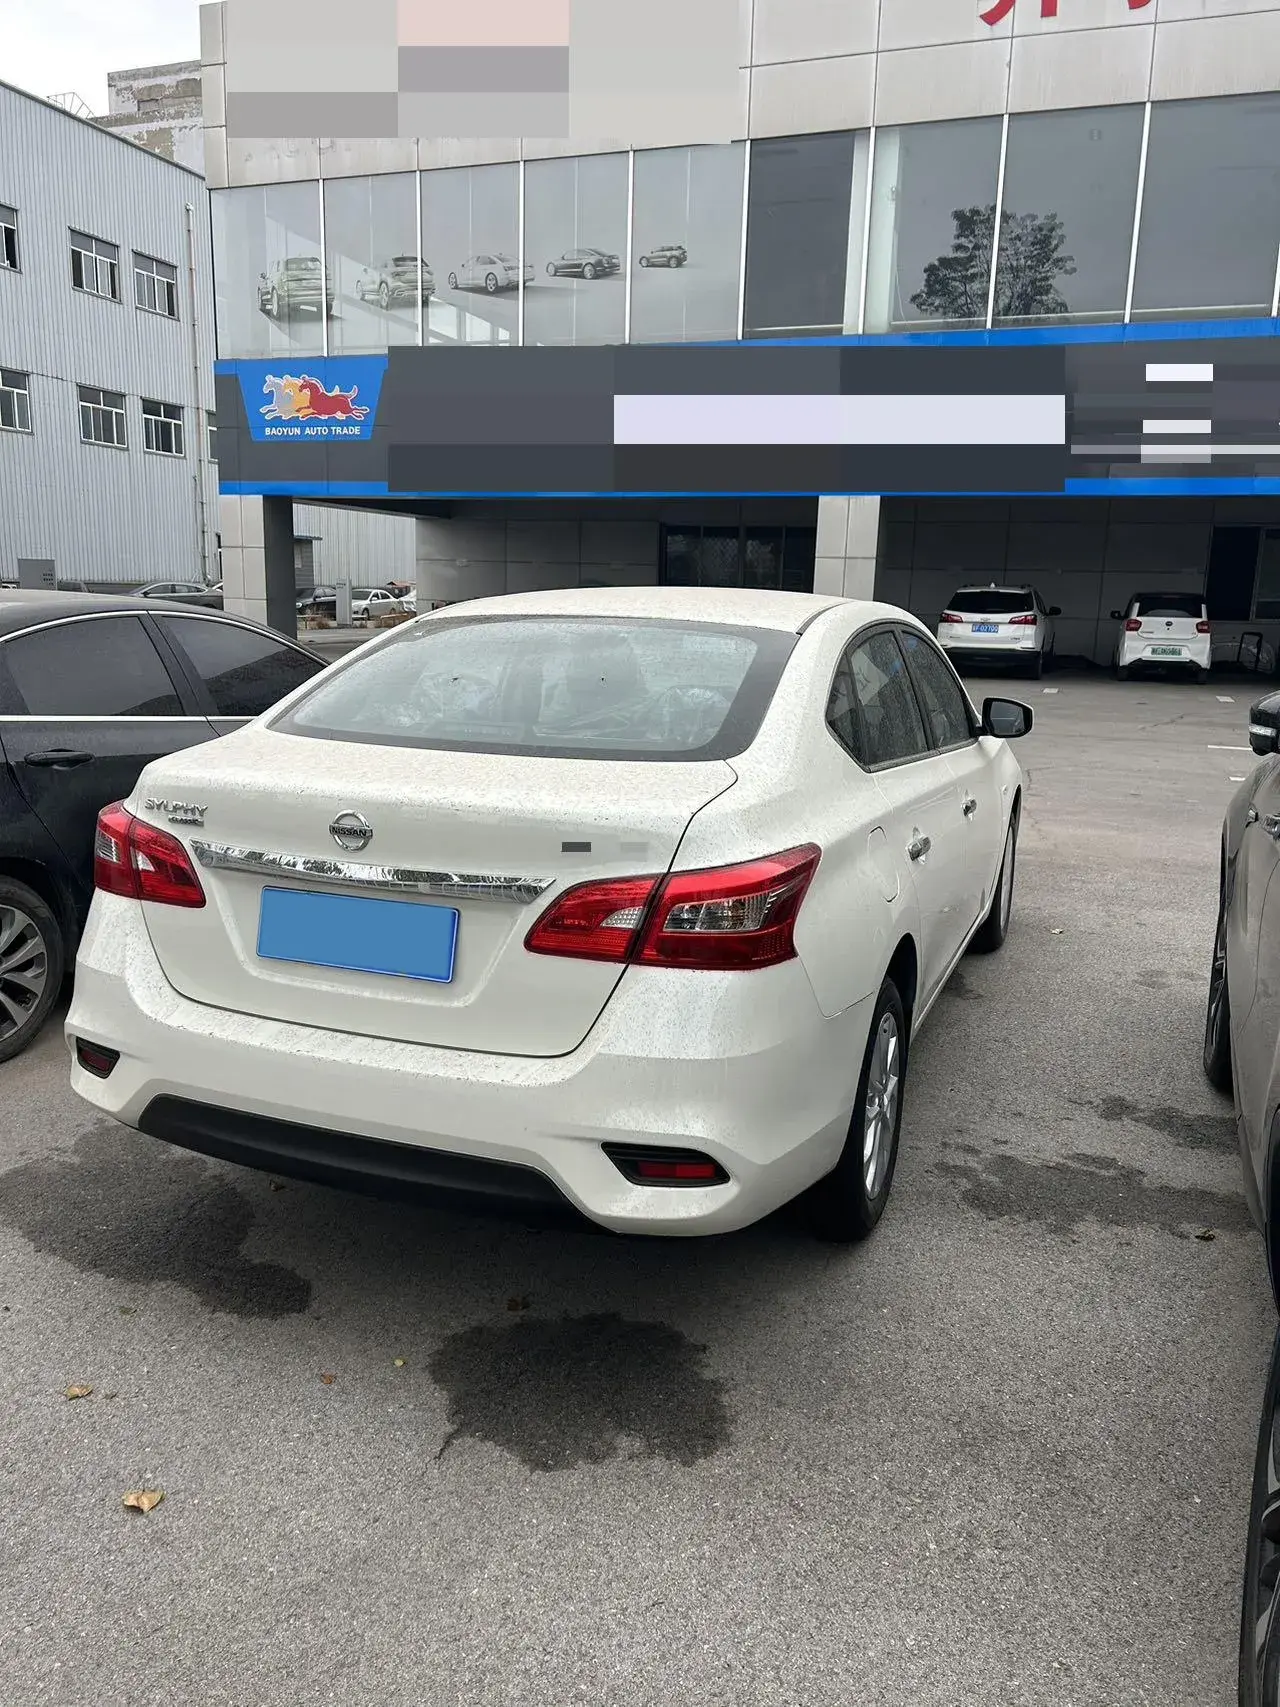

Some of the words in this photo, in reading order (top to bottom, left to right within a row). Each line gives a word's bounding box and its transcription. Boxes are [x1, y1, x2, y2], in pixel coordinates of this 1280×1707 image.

[265, 427, 301, 436] BAOYUN
[304, 426, 329, 435] AUTO
[330, 426, 361, 435] TRADE
[145, 798, 208, 817] SYLPHY
[331, 826, 368, 837] NISSAN
